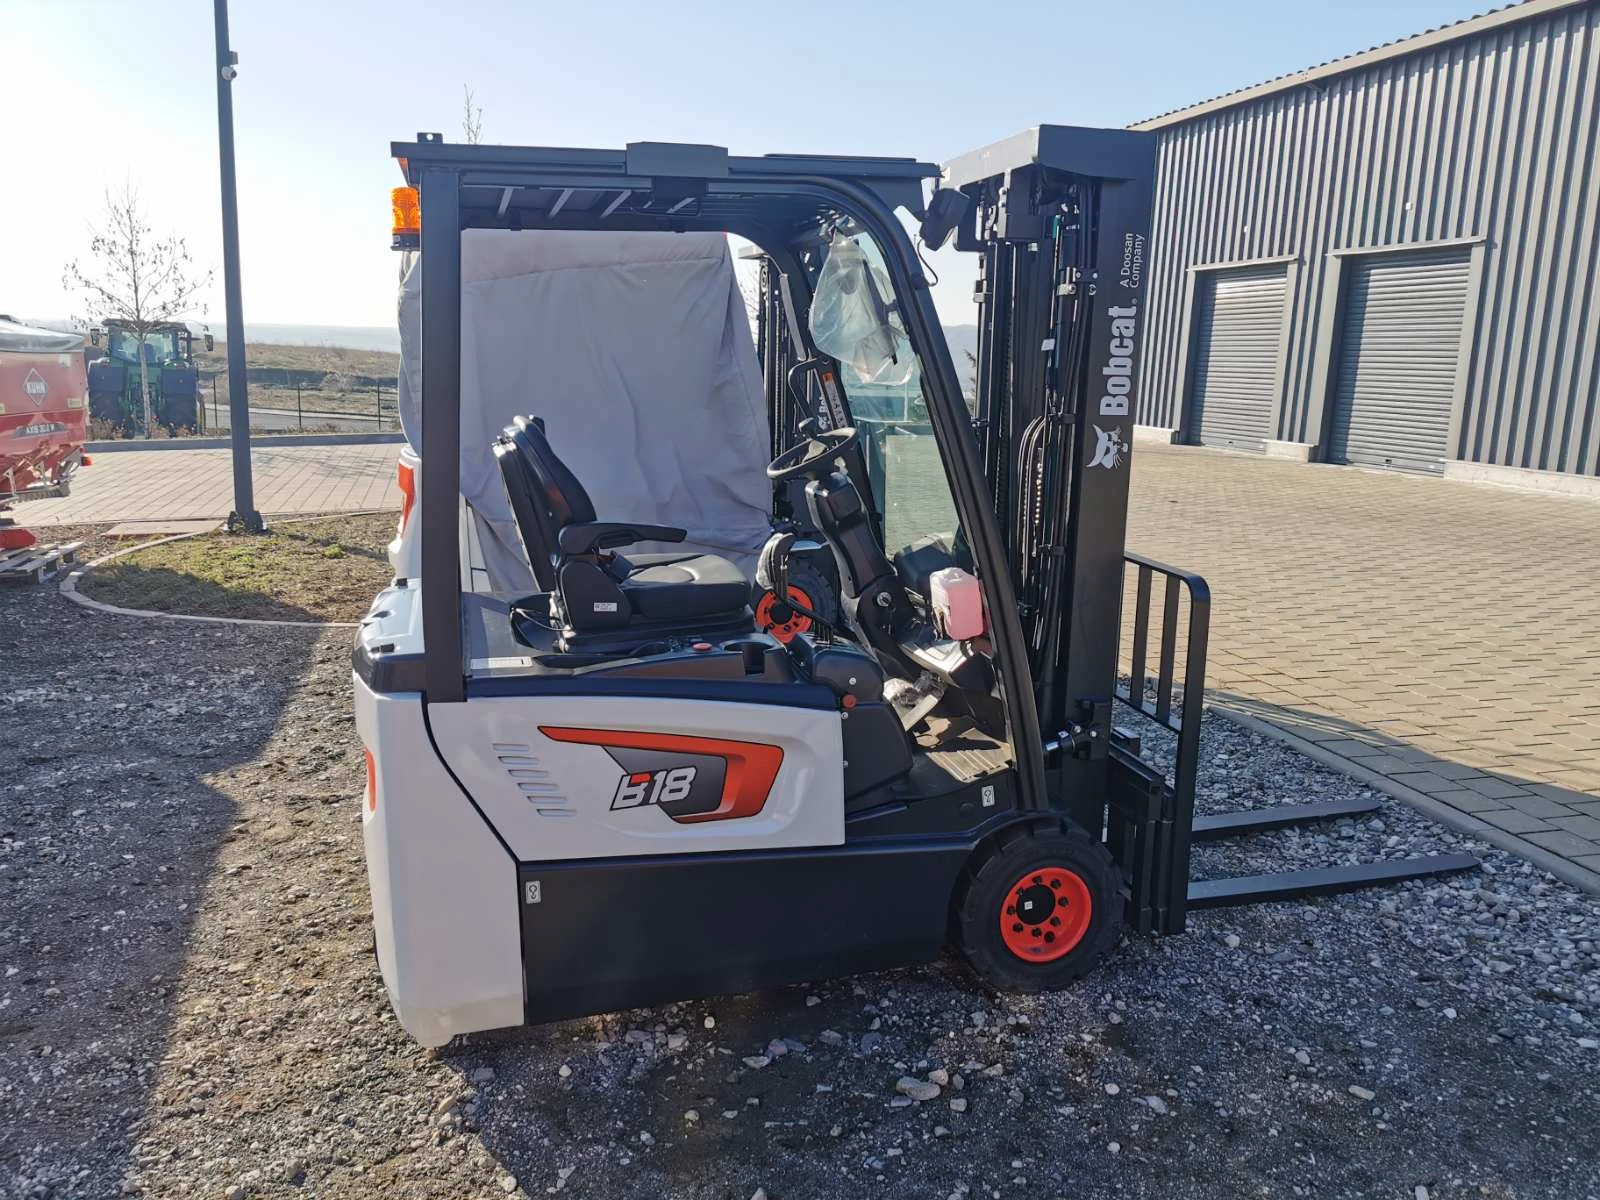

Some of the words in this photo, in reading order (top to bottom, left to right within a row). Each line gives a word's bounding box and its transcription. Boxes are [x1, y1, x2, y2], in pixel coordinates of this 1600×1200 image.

[1121, 233, 1134, 276] Doosan
[1129, 234, 1145, 288] Company
[1120, 279, 1130, 288] A
[1100, 306, 1137, 416] Bobcat
[610, 766, 697, 810] B18
